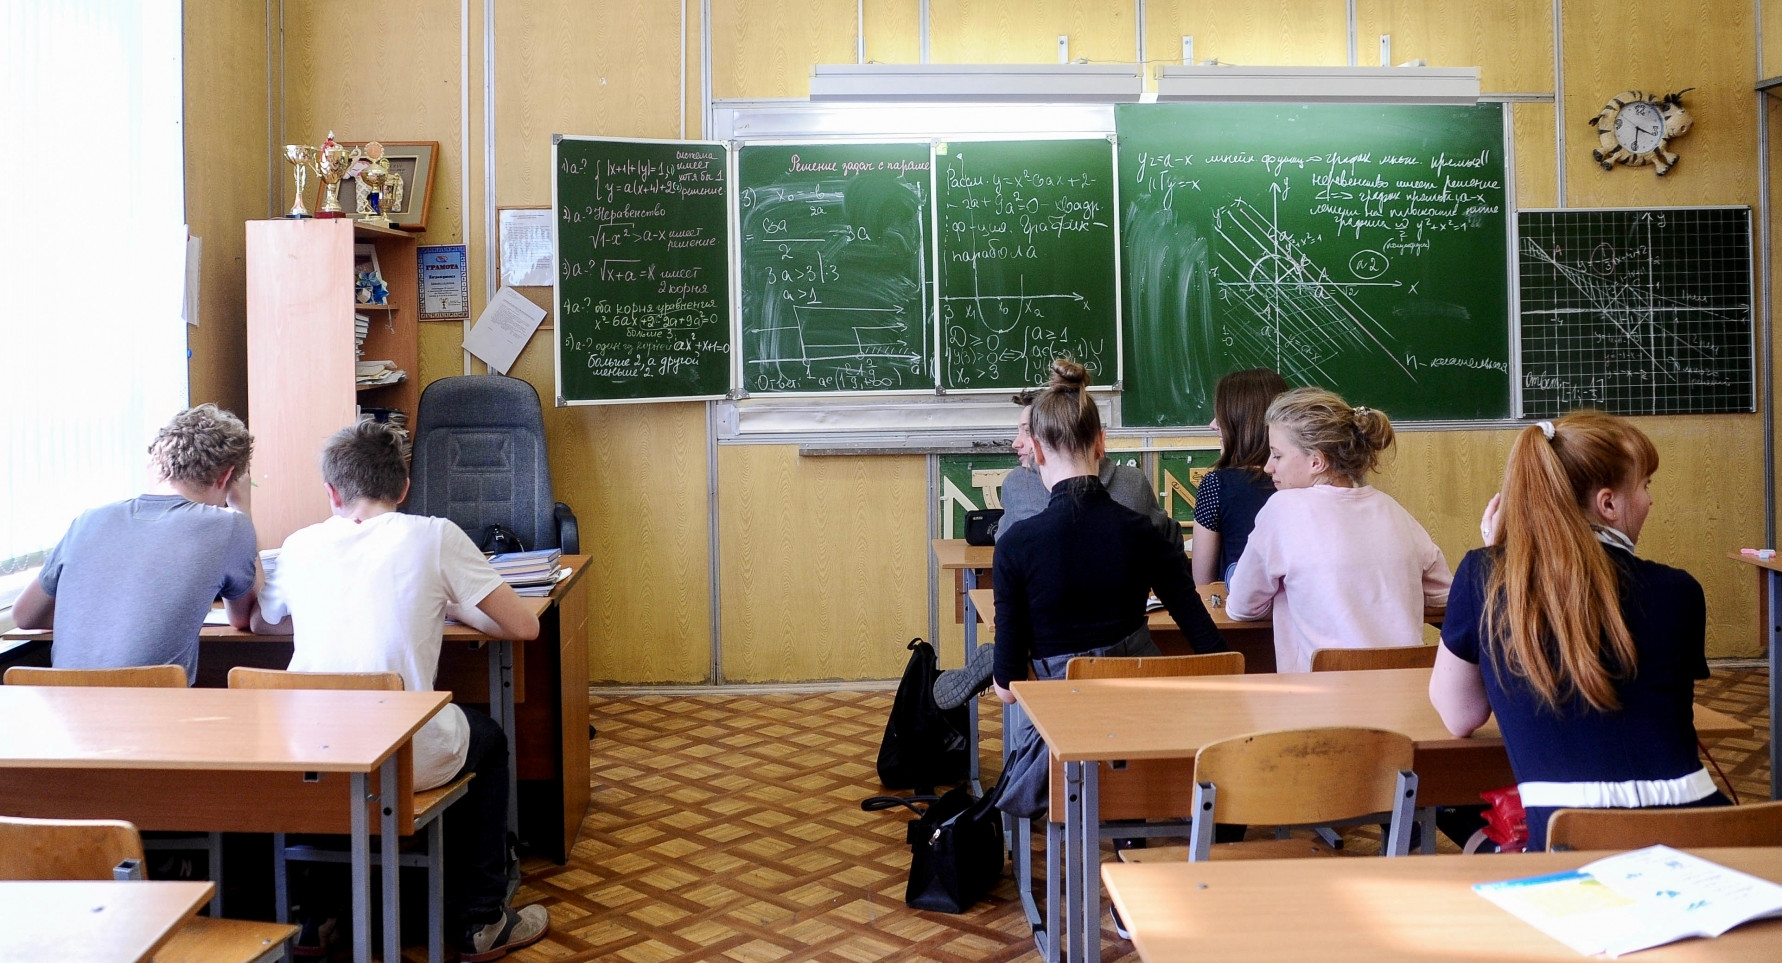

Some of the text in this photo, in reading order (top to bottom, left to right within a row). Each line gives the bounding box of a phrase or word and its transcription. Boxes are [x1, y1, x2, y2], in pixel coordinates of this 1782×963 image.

[788, 154, 838, 173] Решение
[841, 159, 875, 176] задач
[878, 161, 884, 171] с
[594, 203, 666, 225] Неравенство
[425, 263, 459, 271] ГРАМОТА
[587, 354, 631, 368] больше
